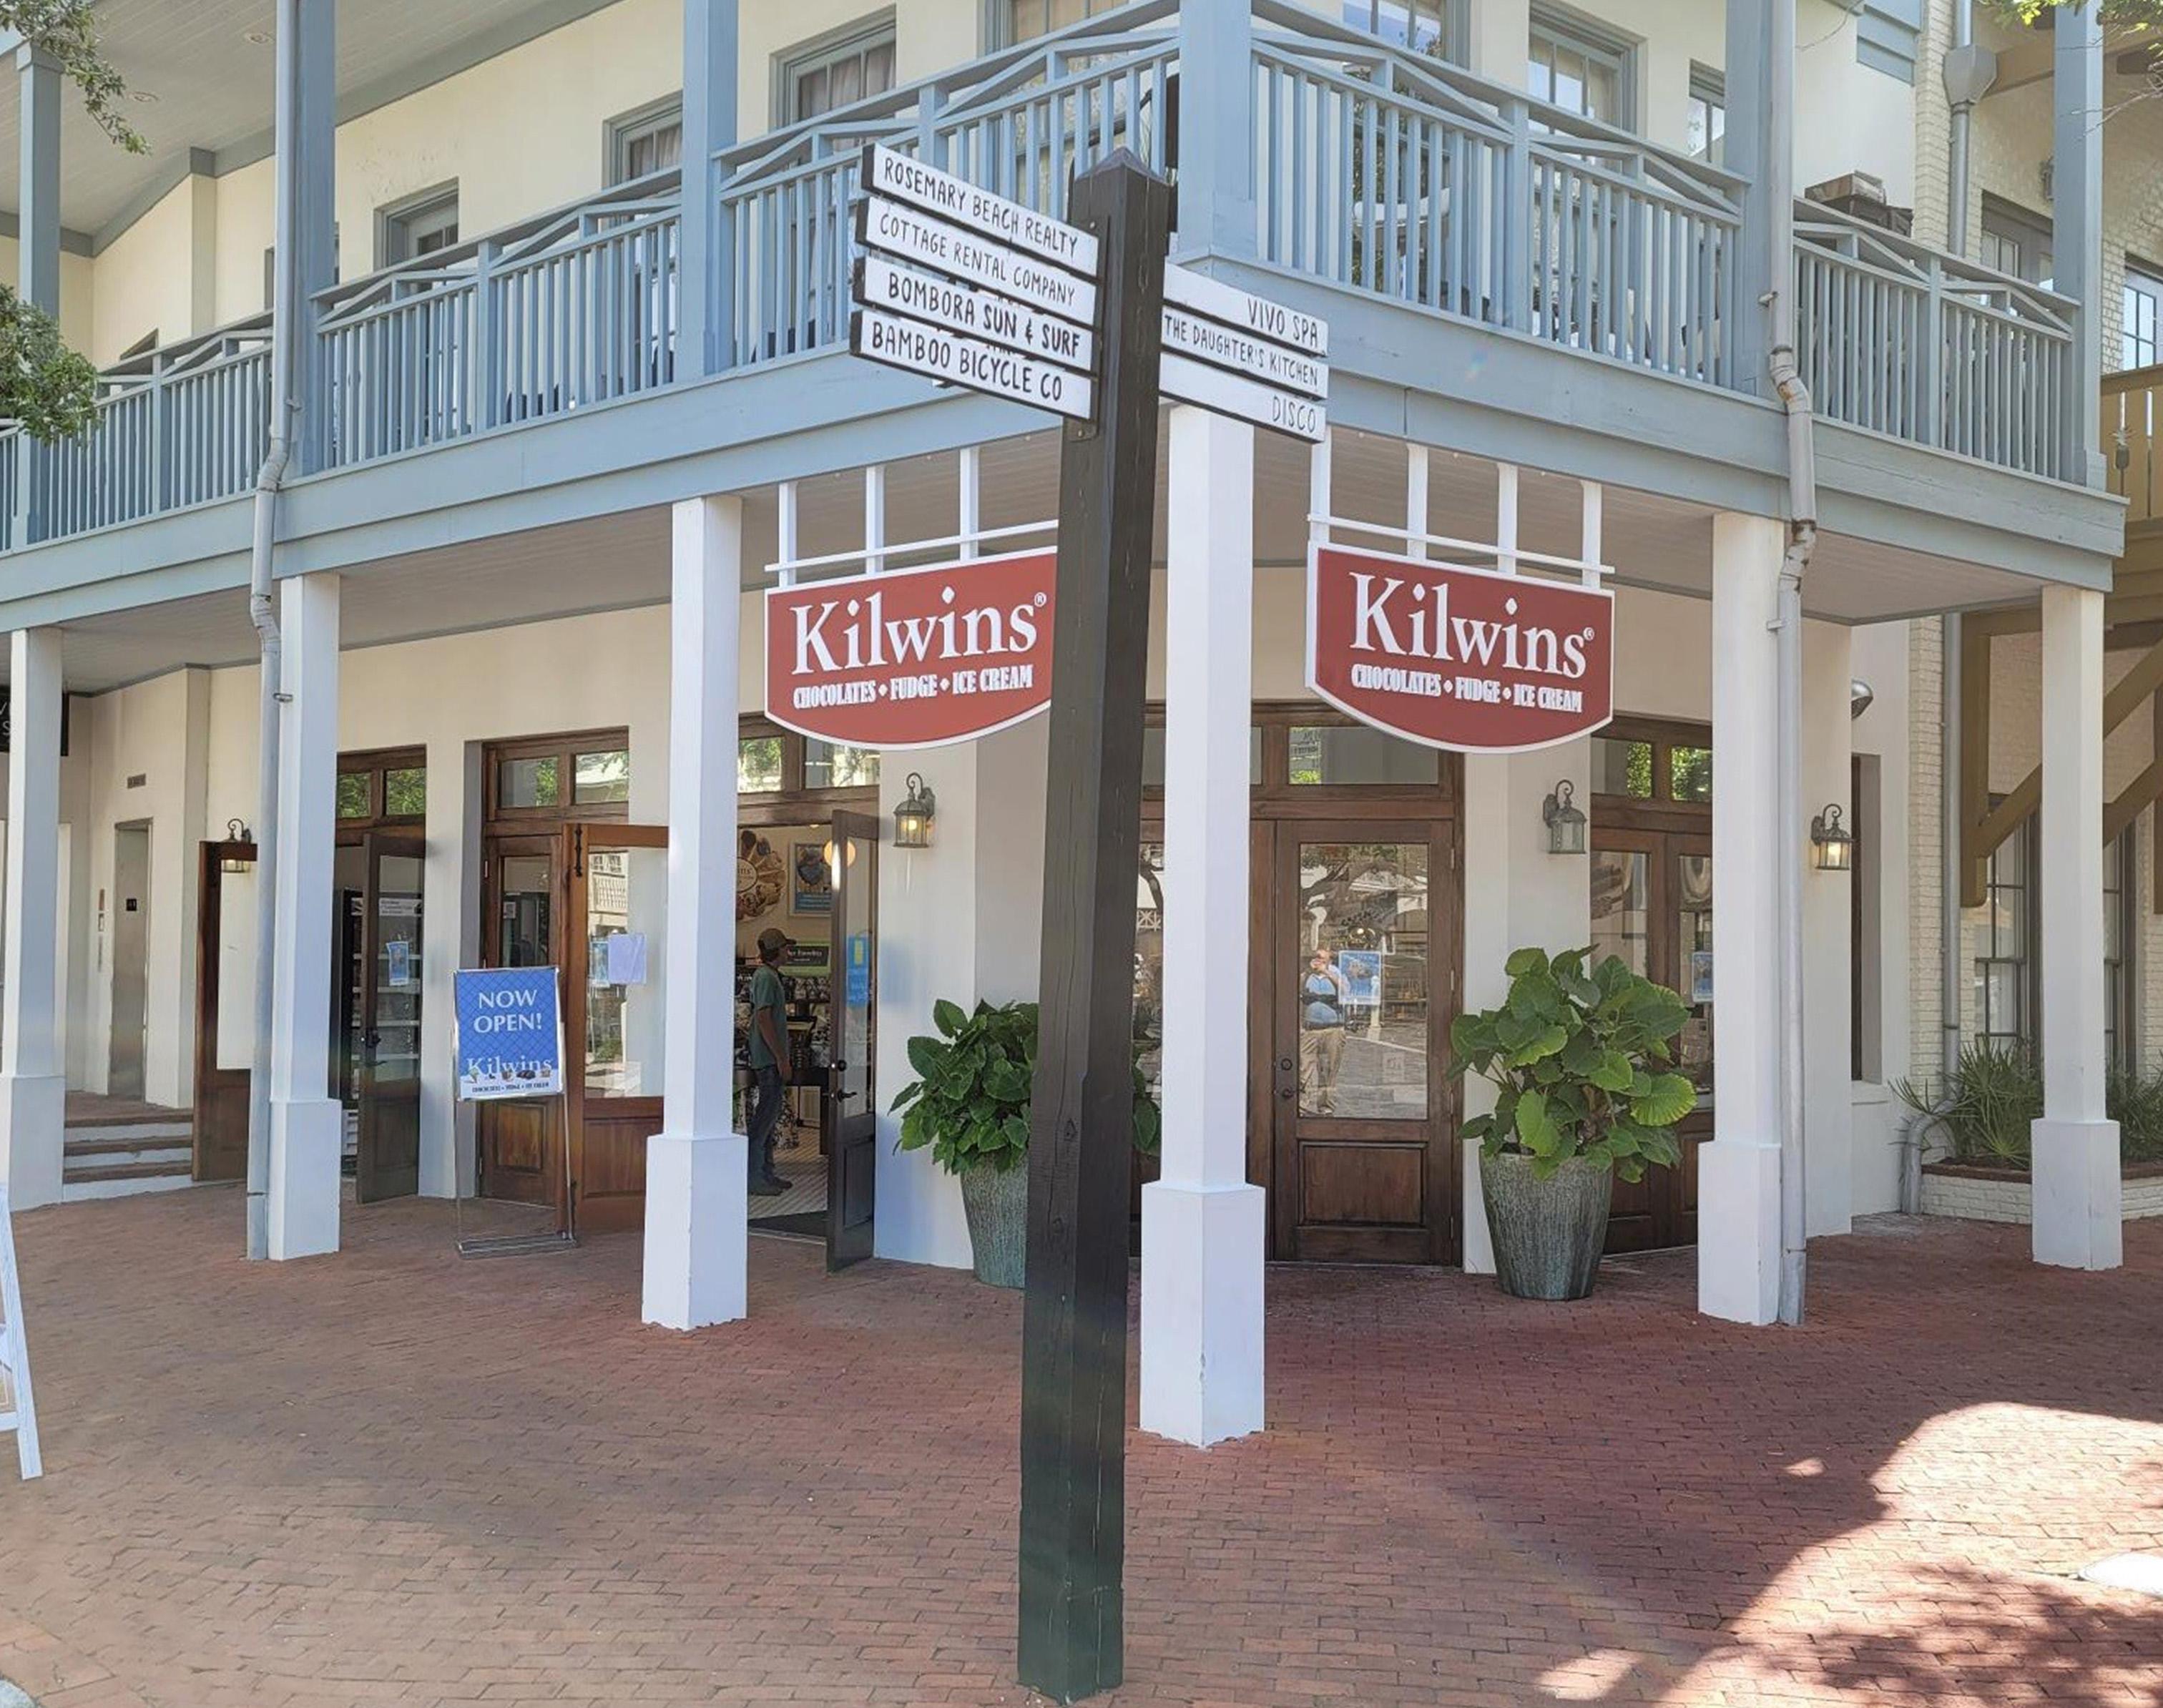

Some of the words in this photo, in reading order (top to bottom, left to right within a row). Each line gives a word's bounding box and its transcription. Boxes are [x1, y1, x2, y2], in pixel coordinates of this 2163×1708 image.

[884, 157, 966, 211] ROSEMARY
[973, 195, 1019, 235] BEACH
[1026, 217, 1078, 259] REALTY
[880, 212, 947, 257] COTTAGE
[953, 245, 1006, 281] RENTAL
[1014, 265, 1075, 306] COMPANY
[888, 272, 975, 326] BOMBORA
[983, 303, 1017, 339] SUN
[1024, 318, 1034, 345] &
[1041, 324, 1079, 358] SURF
[1247, 298, 1285, 335] VIVO
[1293, 315, 1318, 348] SPA
[872, 320, 951, 369] BAMBOO
[960, 346, 1032, 393] BICYCLE
[1040, 373, 1062, 401] CO
[1164, 314, 1187, 342] THE
[1193, 325, 1265, 368] DAUGHTER'S
[1269, 352, 1318, 386] KITCHEN
[1272, 396, 1317, 433] DISCO
[793, 679, 876, 710] CHOCOLATES
[889, 674, 938, 701] FUDGE
[952, 669, 977, 695] ICE
[979, 664, 1034, 692] CREAM
[1350, 662, 1442, 698] CHOCOLATES
[1455, 676, 1501, 704] FUDGE
[1513, 684, 1536, 707] ICE
[1537, 686, 1583, 714] CREAM
[474, 1013, 542, 1034] OPEN!
[479, 989, 537, 1009] NOW
